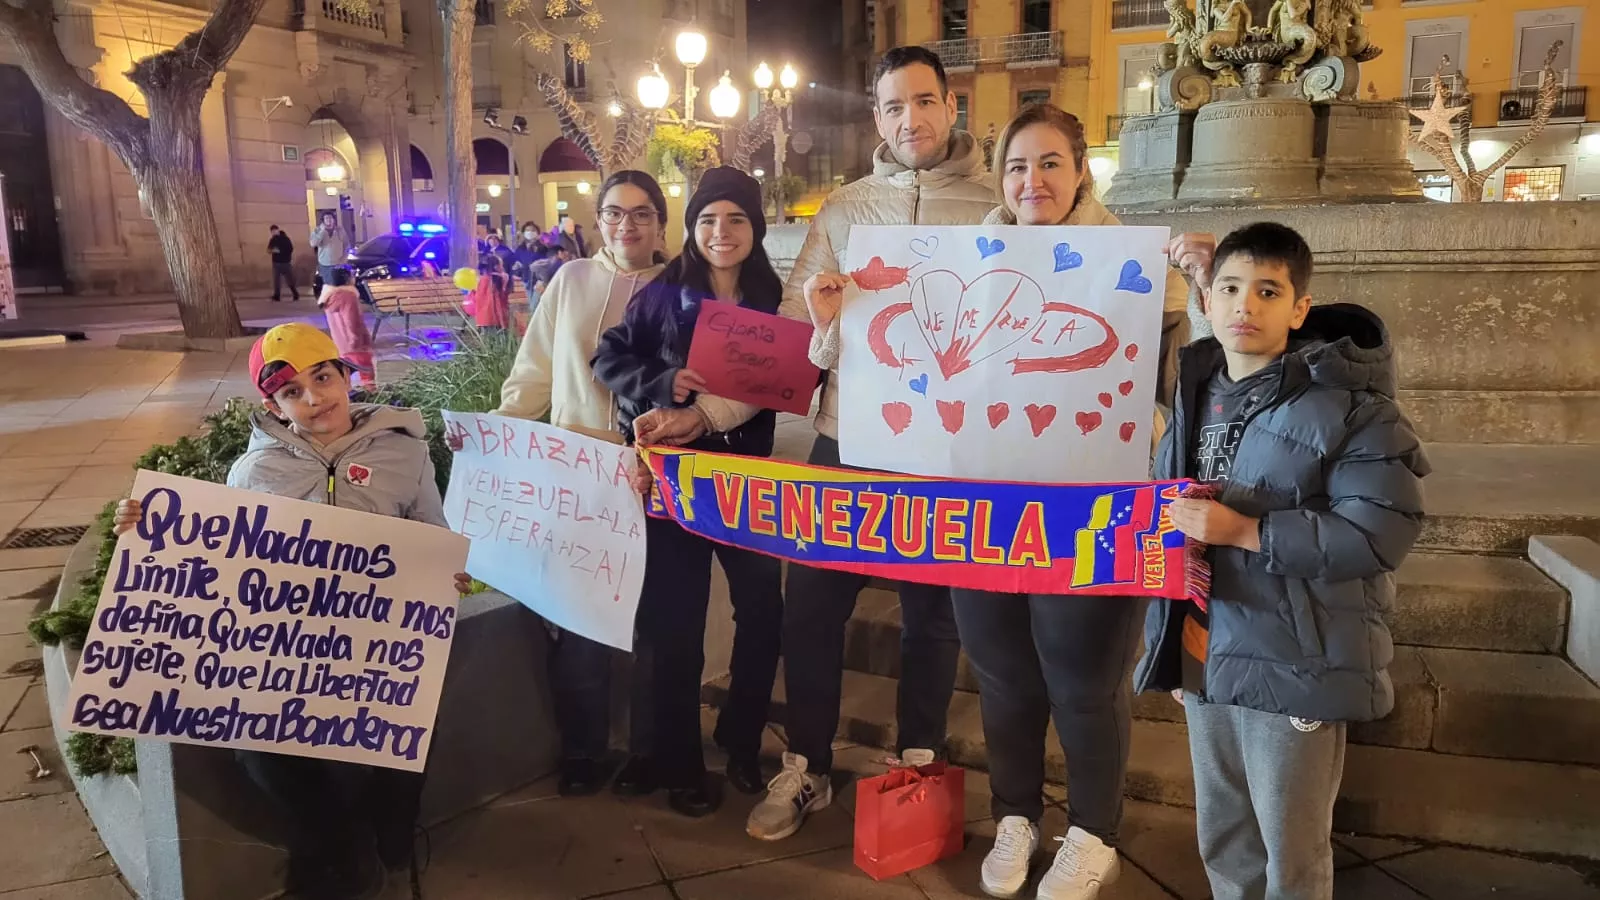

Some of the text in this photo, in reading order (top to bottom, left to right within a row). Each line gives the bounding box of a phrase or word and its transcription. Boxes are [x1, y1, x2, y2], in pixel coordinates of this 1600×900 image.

[708, 311, 775, 343] Gloria
[1198, 422, 1244, 449] STA
[711, 470, 1052, 567] VENEZUELA
[461, 497, 627, 602] ESPERANZA!
[400, 600, 455, 640] nos
[194, 652, 257, 690] Que
[365, 638, 425, 672] nos
[276, 697, 427, 760] Bandera
